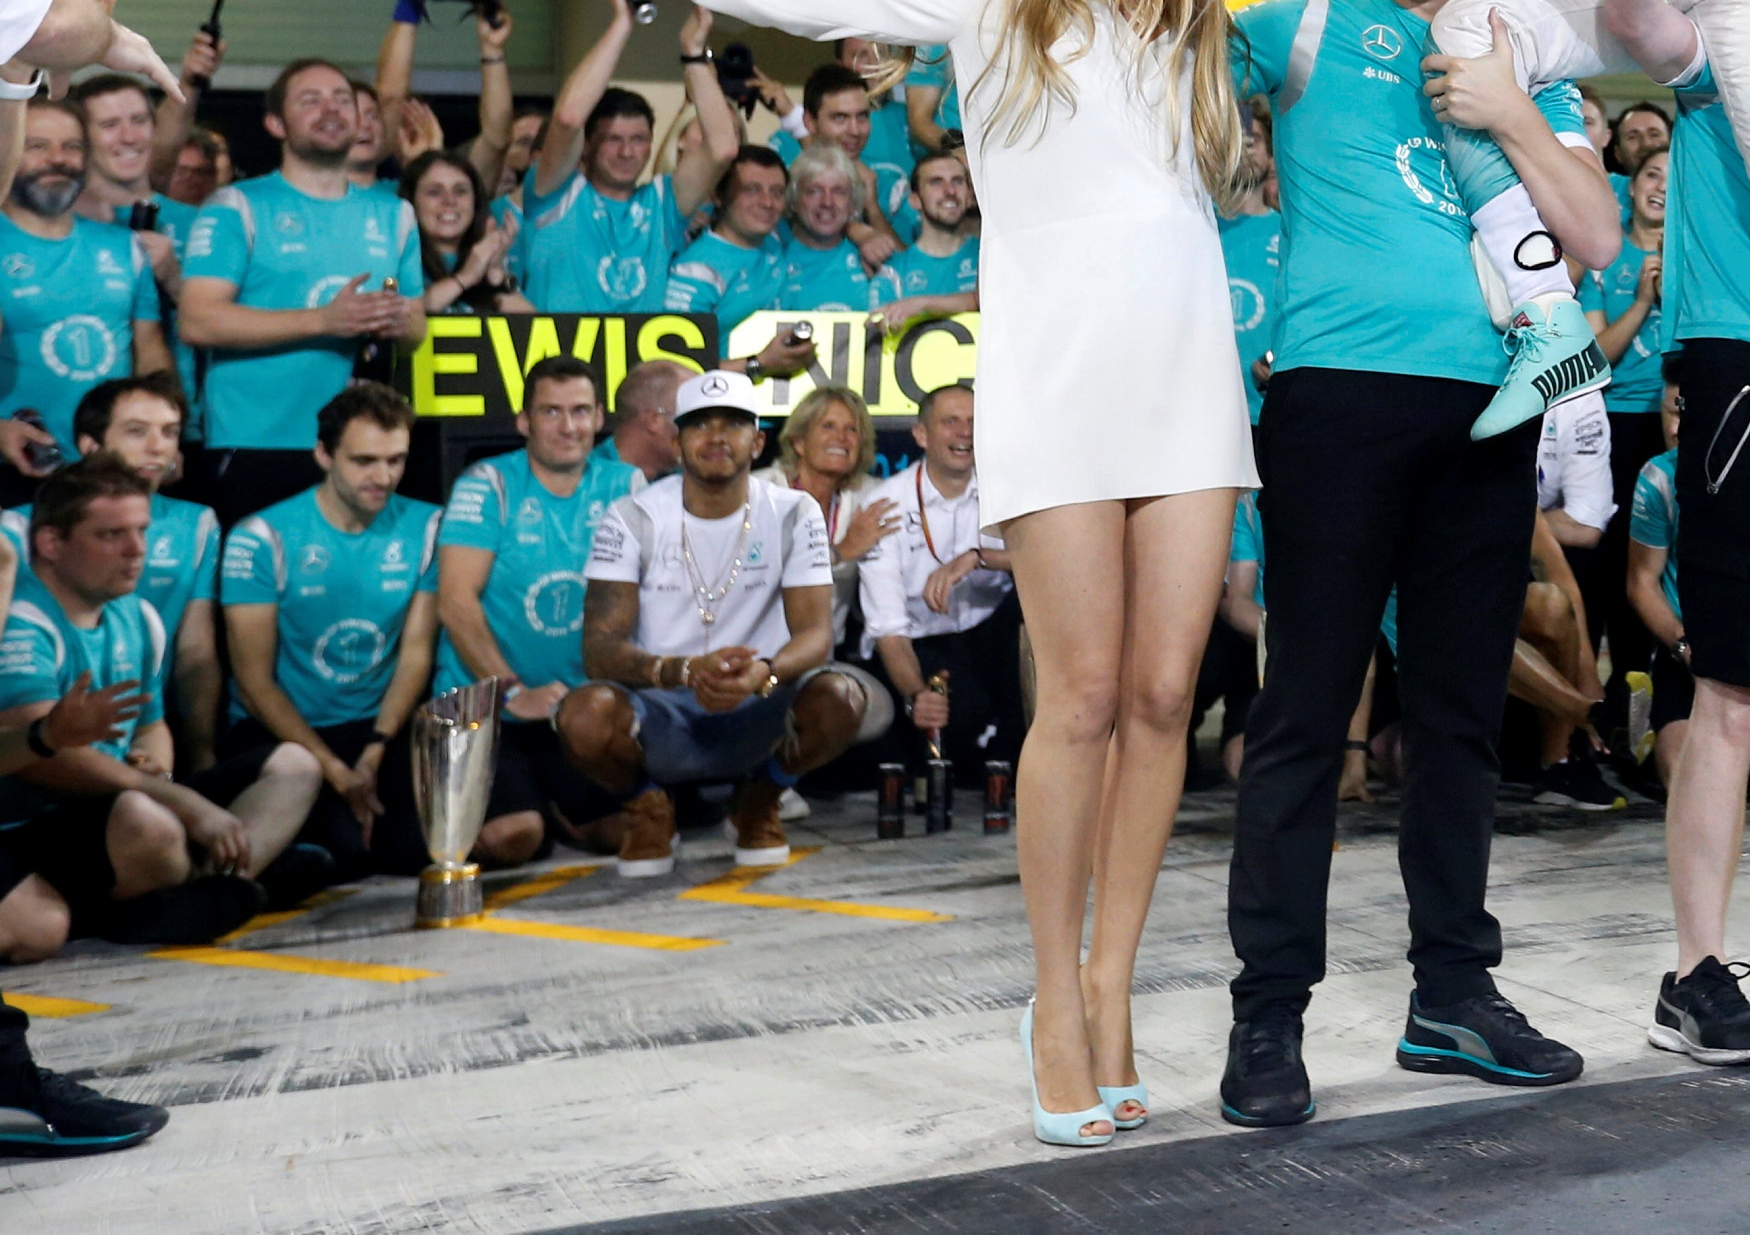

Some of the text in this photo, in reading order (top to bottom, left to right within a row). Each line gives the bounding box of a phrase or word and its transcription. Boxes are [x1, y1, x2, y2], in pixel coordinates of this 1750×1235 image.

[1377, 69, 1401, 84] UBS
[1438, 201, 1466, 217] 201
[1530, 339, 1608, 409] PUMA
